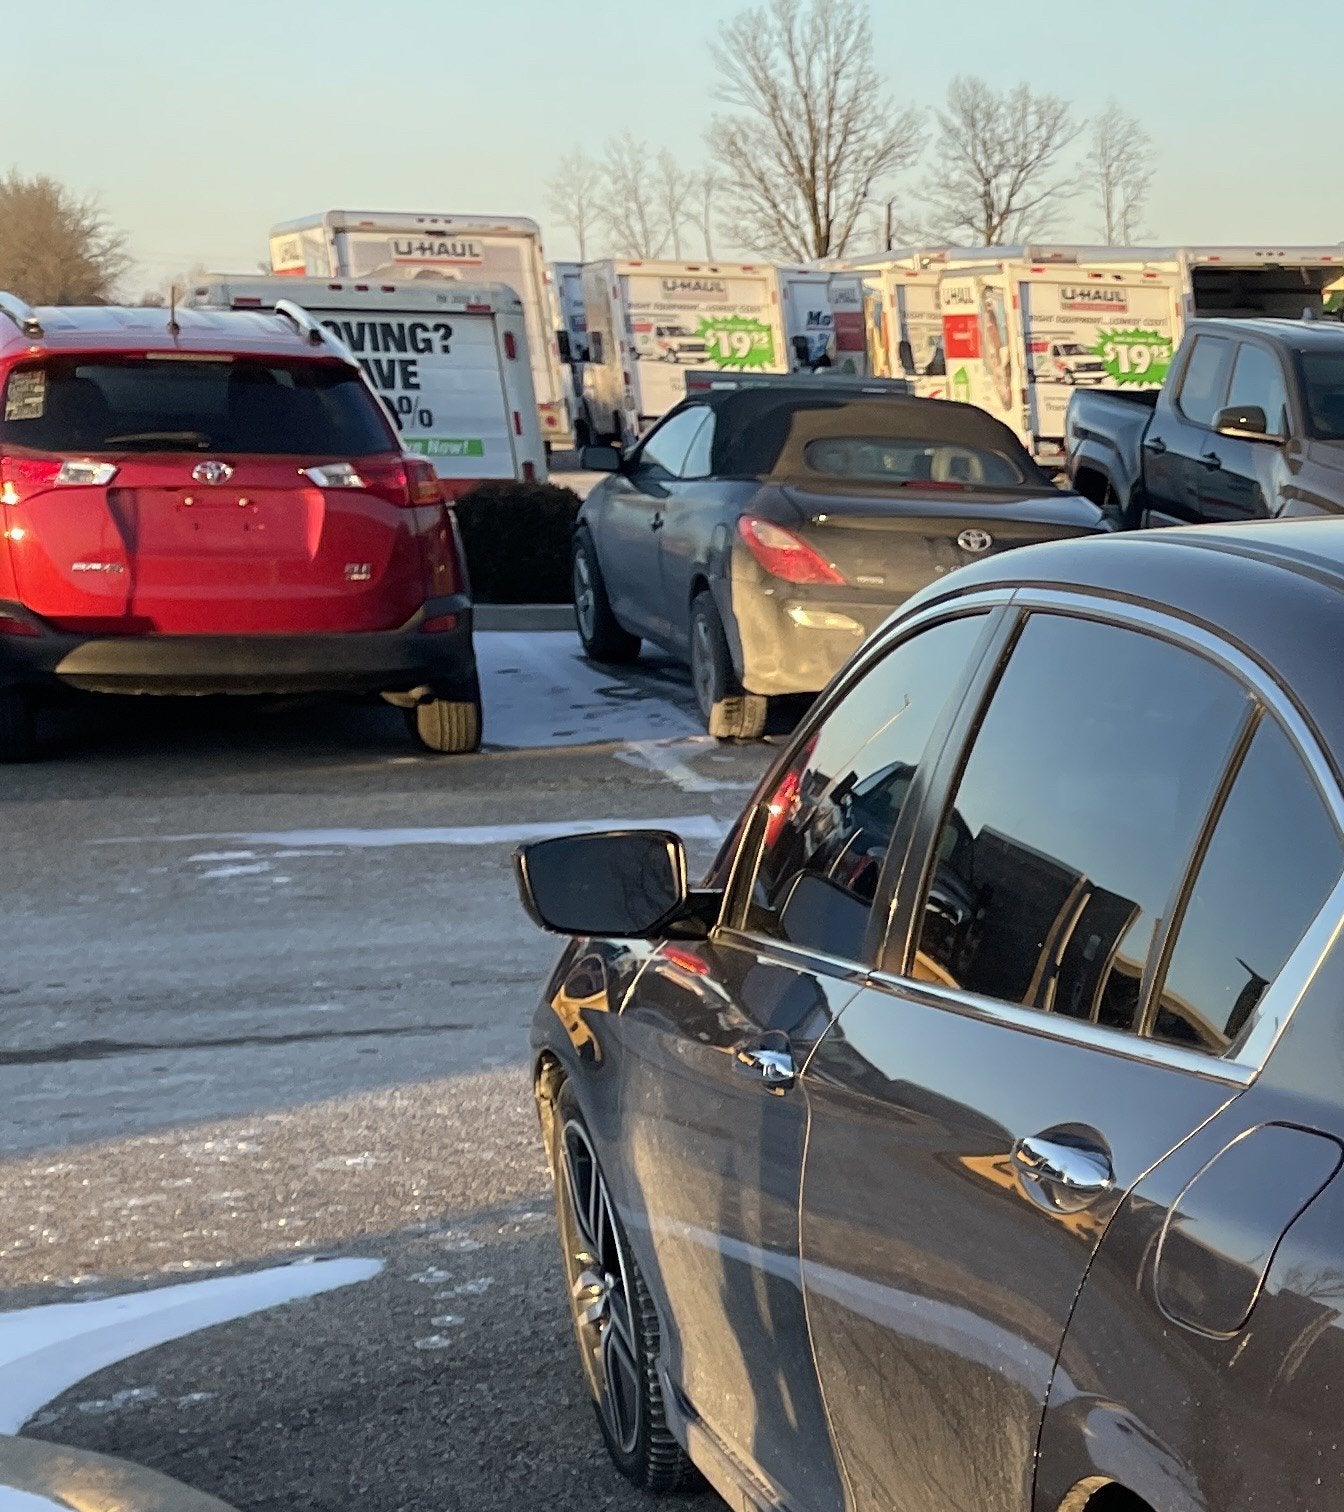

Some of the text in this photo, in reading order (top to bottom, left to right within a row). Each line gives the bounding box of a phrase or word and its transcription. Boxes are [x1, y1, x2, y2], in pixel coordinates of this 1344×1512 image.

[393, 241, 481, 258] U-HAUL
[1062, 288, 1125, 301] U-HAUL
[319, 321, 453, 354] OVING?
[363, 359, 421, 390] AVE
